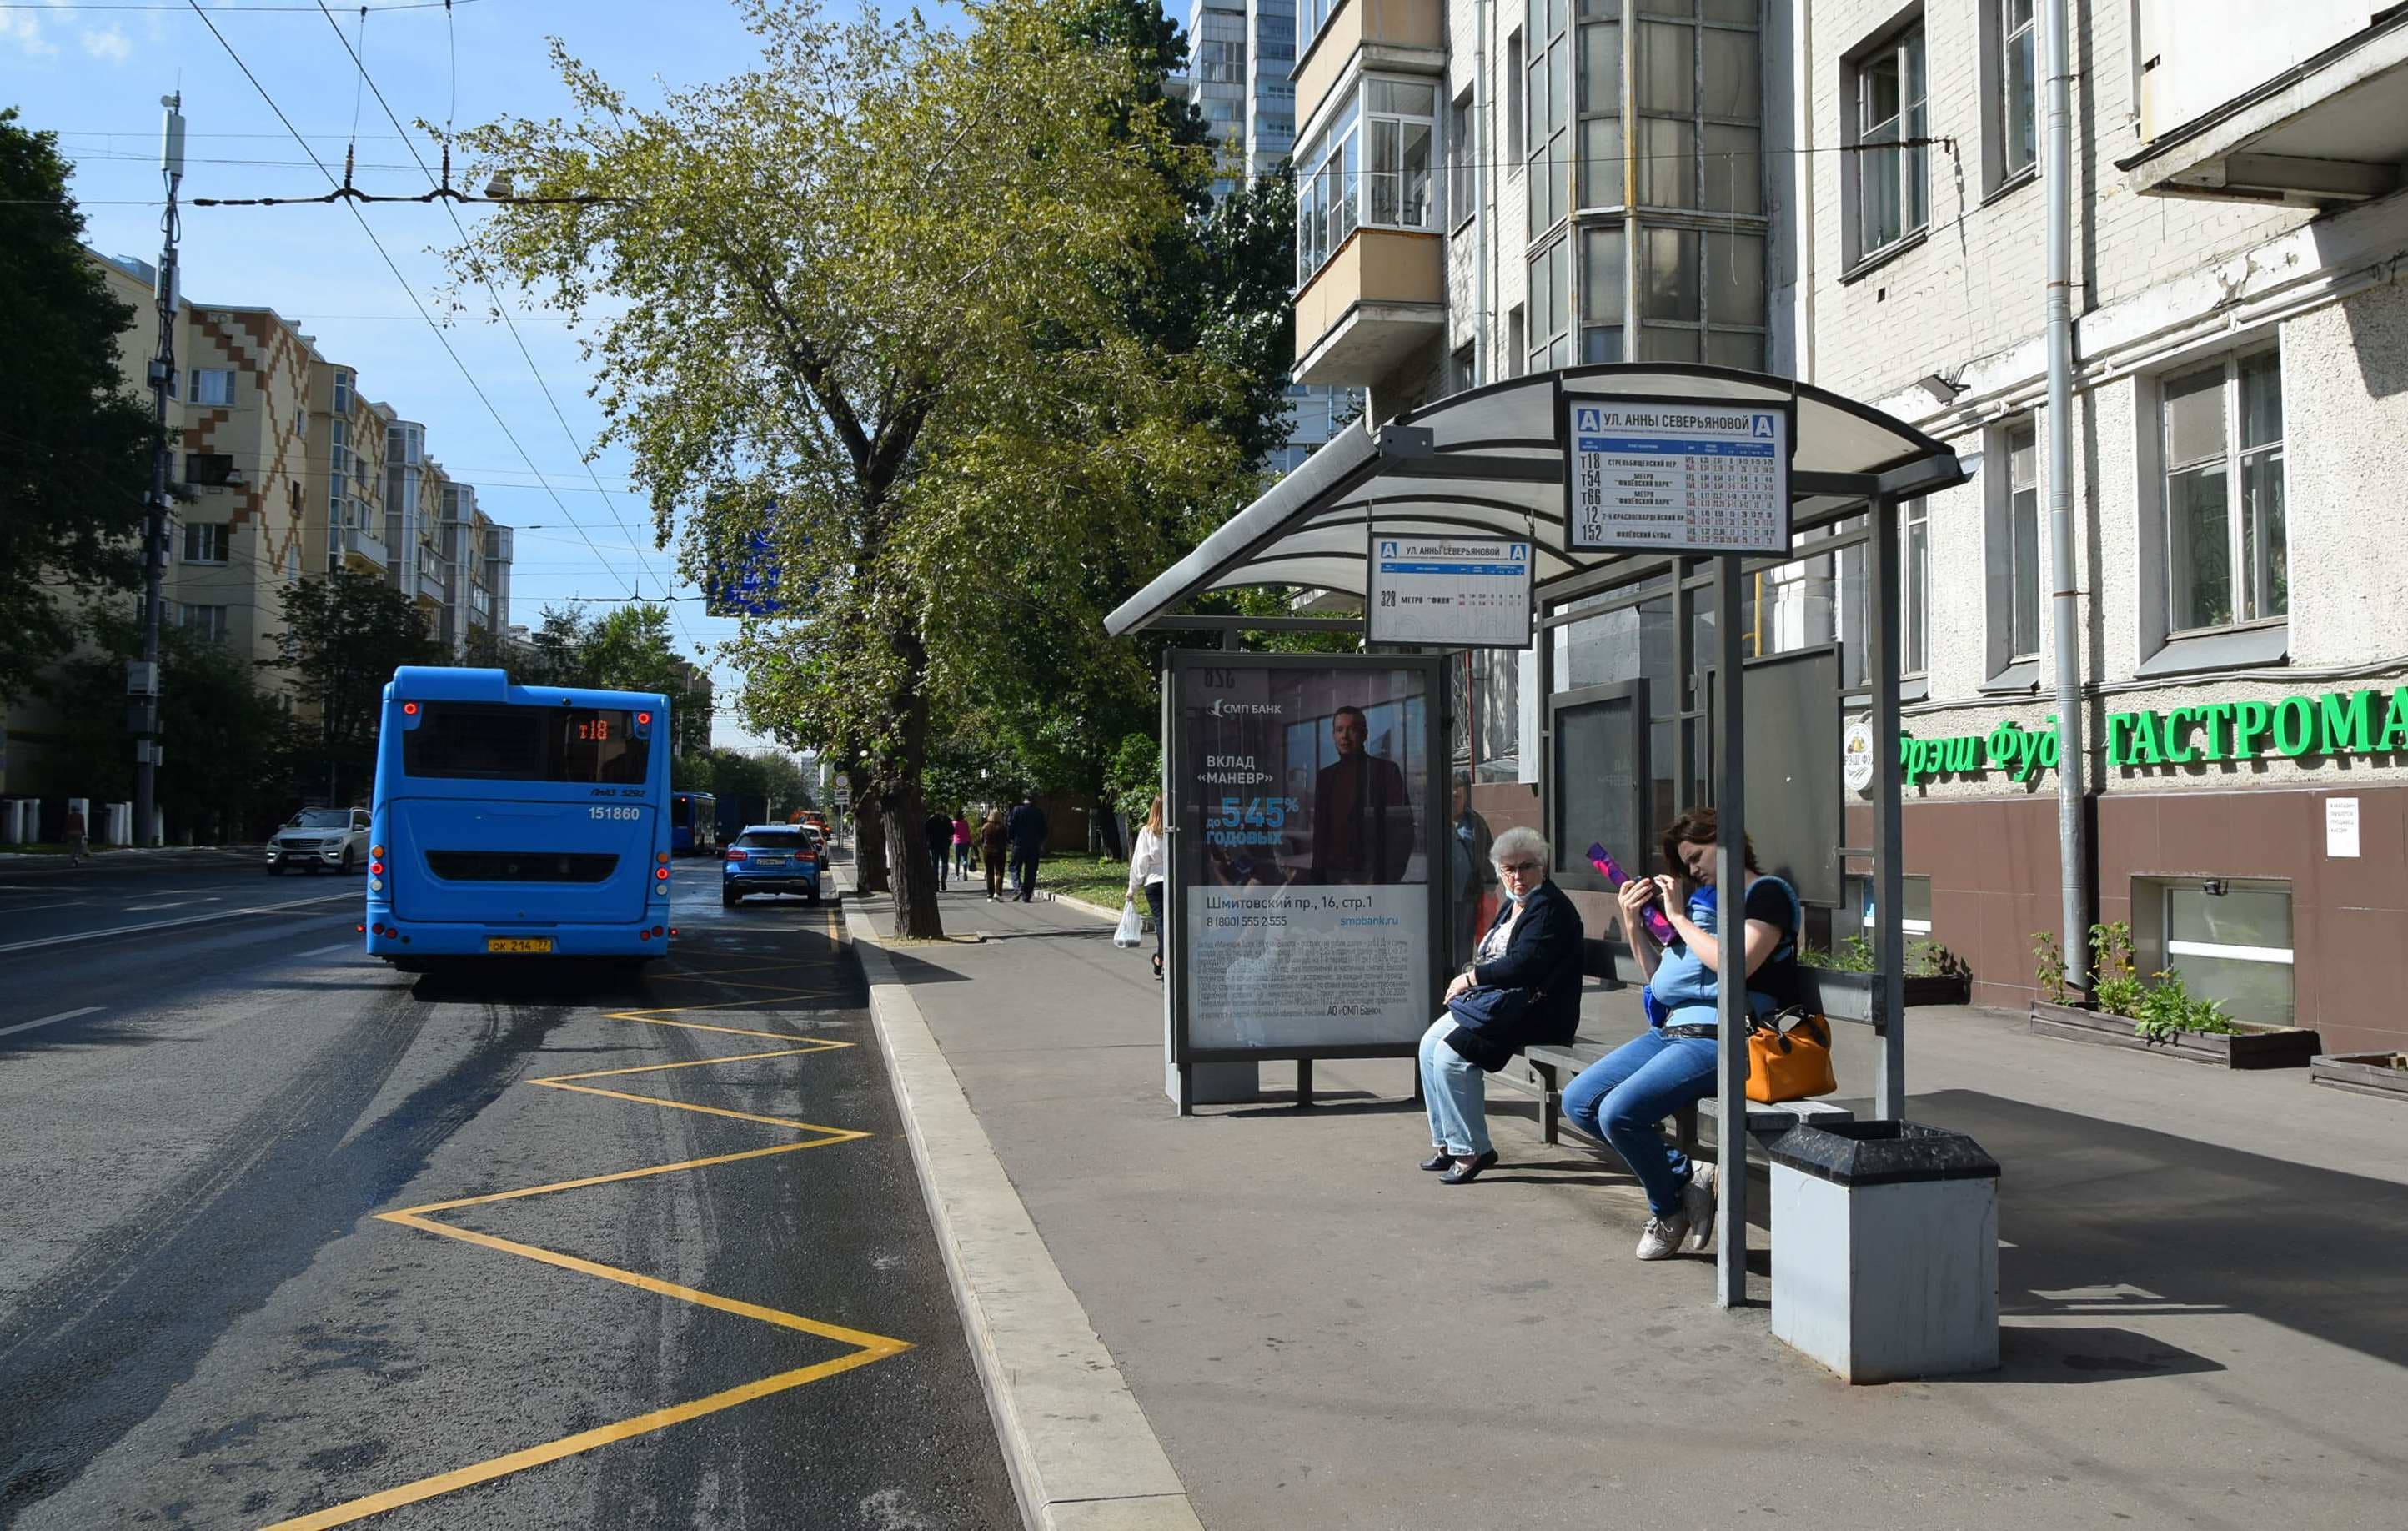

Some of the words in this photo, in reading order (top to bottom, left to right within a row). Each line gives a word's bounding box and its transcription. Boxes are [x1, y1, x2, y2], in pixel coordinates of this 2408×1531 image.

[1603, 414, 1622, 425] УЛ.
[1625, 414, 1658, 427] АННЫ
[1662, 414, 1749, 430] СЕВЕРЬЯНОВОЙ
[1585, 506, 1598, 523] 12
[1582, 525, 1601, 541] 152
[1406, 546, 1418, 555] УЛ.
[1419, 546, 1441, 555] АННЫ
[1443, 547, 1500, 557] СЕВЕРЬЯНОВОЙ
[1223, 704, 1248, 714] СМП
[1252, 704, 1282, 715] БАНК
[1207, 755, 1256, 770] ВКЛАД
[1900, 734, 1975, 786] рэш
[1197, 772, 1273, 784] «МАНЕВР»
[589, 806, 640, 820] 151860
[1206, 818, 1221, 828] до
[1206, 831, 1282, 847] годовых
[1207, 896, 1292, 909] Шмитовский
[1295, 900, 1317, 911] пр.,
[1322, 896, 1339, 910] 16,
[1207, 917, 1213, 927] 8
[1215, 916, 1240, 928] (800)
[1242, 916, 1260, 927] 555
[1262, 916, 1267, 927] 2
[1268, 916, 1287, 927] 555
[1340, 916, 1399, 926] smpbank.ru
[1327, 1006, 1337, 1016] АО
